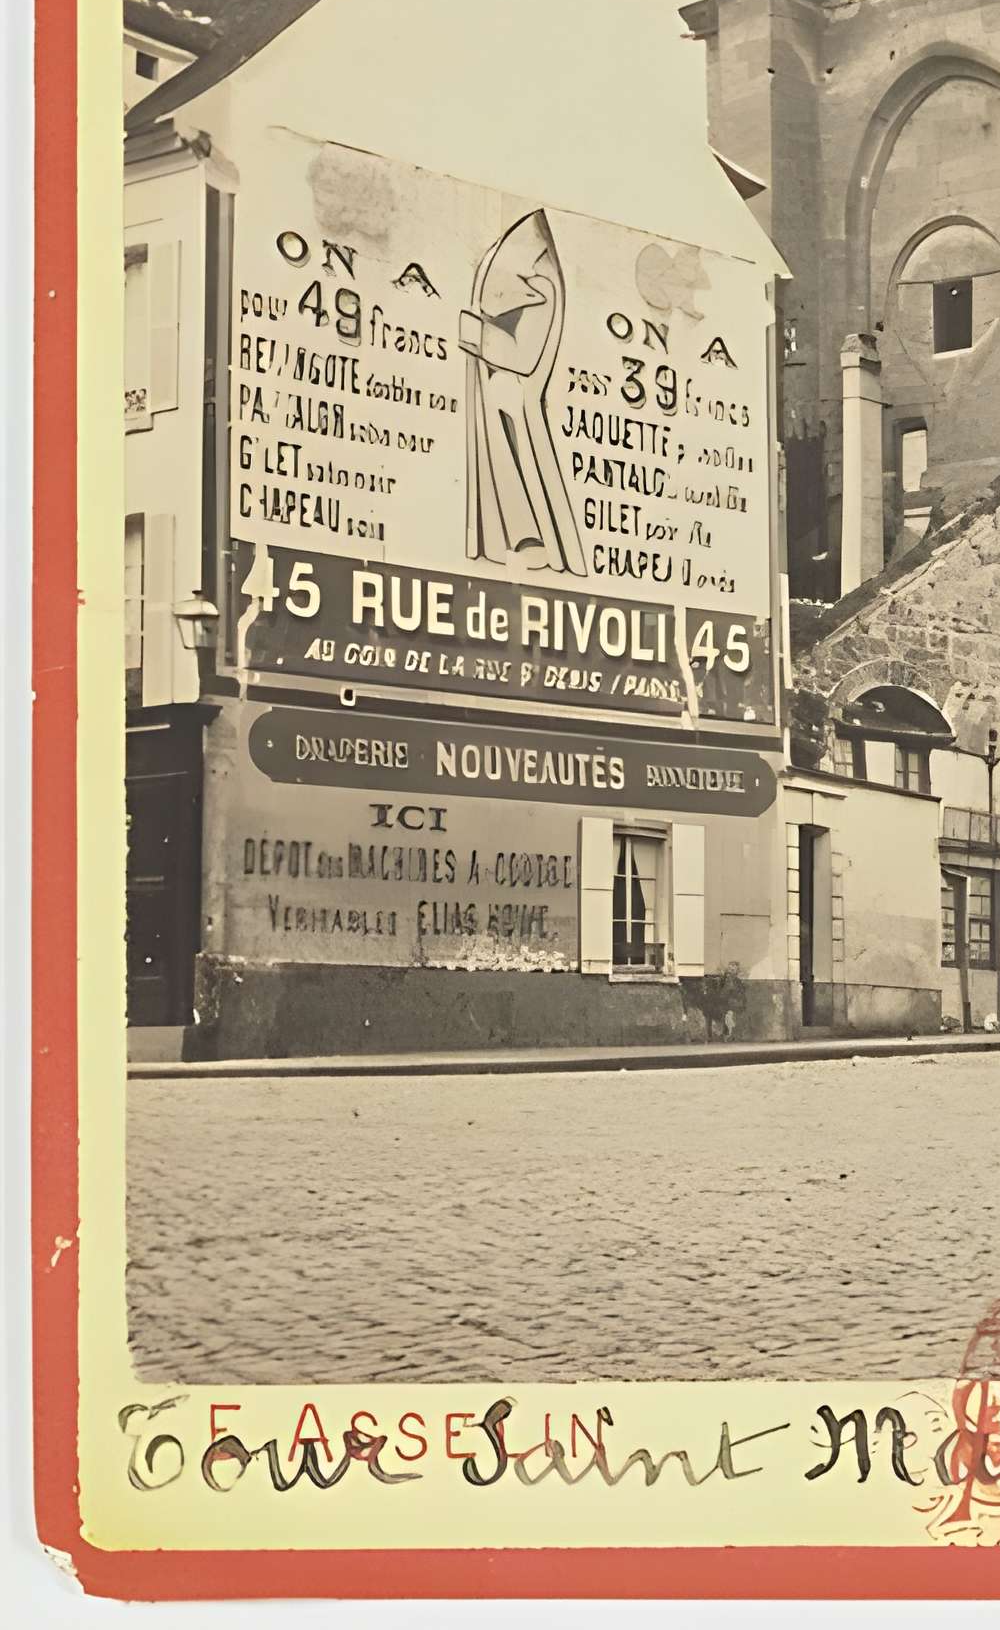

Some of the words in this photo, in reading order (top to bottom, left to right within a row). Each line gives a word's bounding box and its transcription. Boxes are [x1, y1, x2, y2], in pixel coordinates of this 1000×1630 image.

[276, 231, 358, 280] ON
[390, 262, 441, 299] A
[298, 280, 361, 346] 49
[370, 304, 447, 360] francs
[606, 312, 669, 354] ON
[700, 337, 738, 370] A
[621, 356, 678, 416] 39
[240, 435, 302, 478] GLET
[561, 406, 671, 457] JAQUETTE
[584, 497, 642, 536] GILET
[241, 557, 320, 618] 45
[352, 570, 455, 636] RUE
[466, 591, 509, 642] de
[521, 595, 667, 663] RIVOLI
[690, 620, 750, 673] 45
[304, 637, 336, 662] AU
[404, 649, 432, 673] DE
[439, 653, 465, 678] LA
[436, 740, 625, 791] NOUVEAUTÉS
[369, 803, 448, 833] ICI
[119, 1394, 423, 1491] Tour
[462, 1396, 791, 1488] Saint
[288, 1403, 604, 1462] ASSELIN
